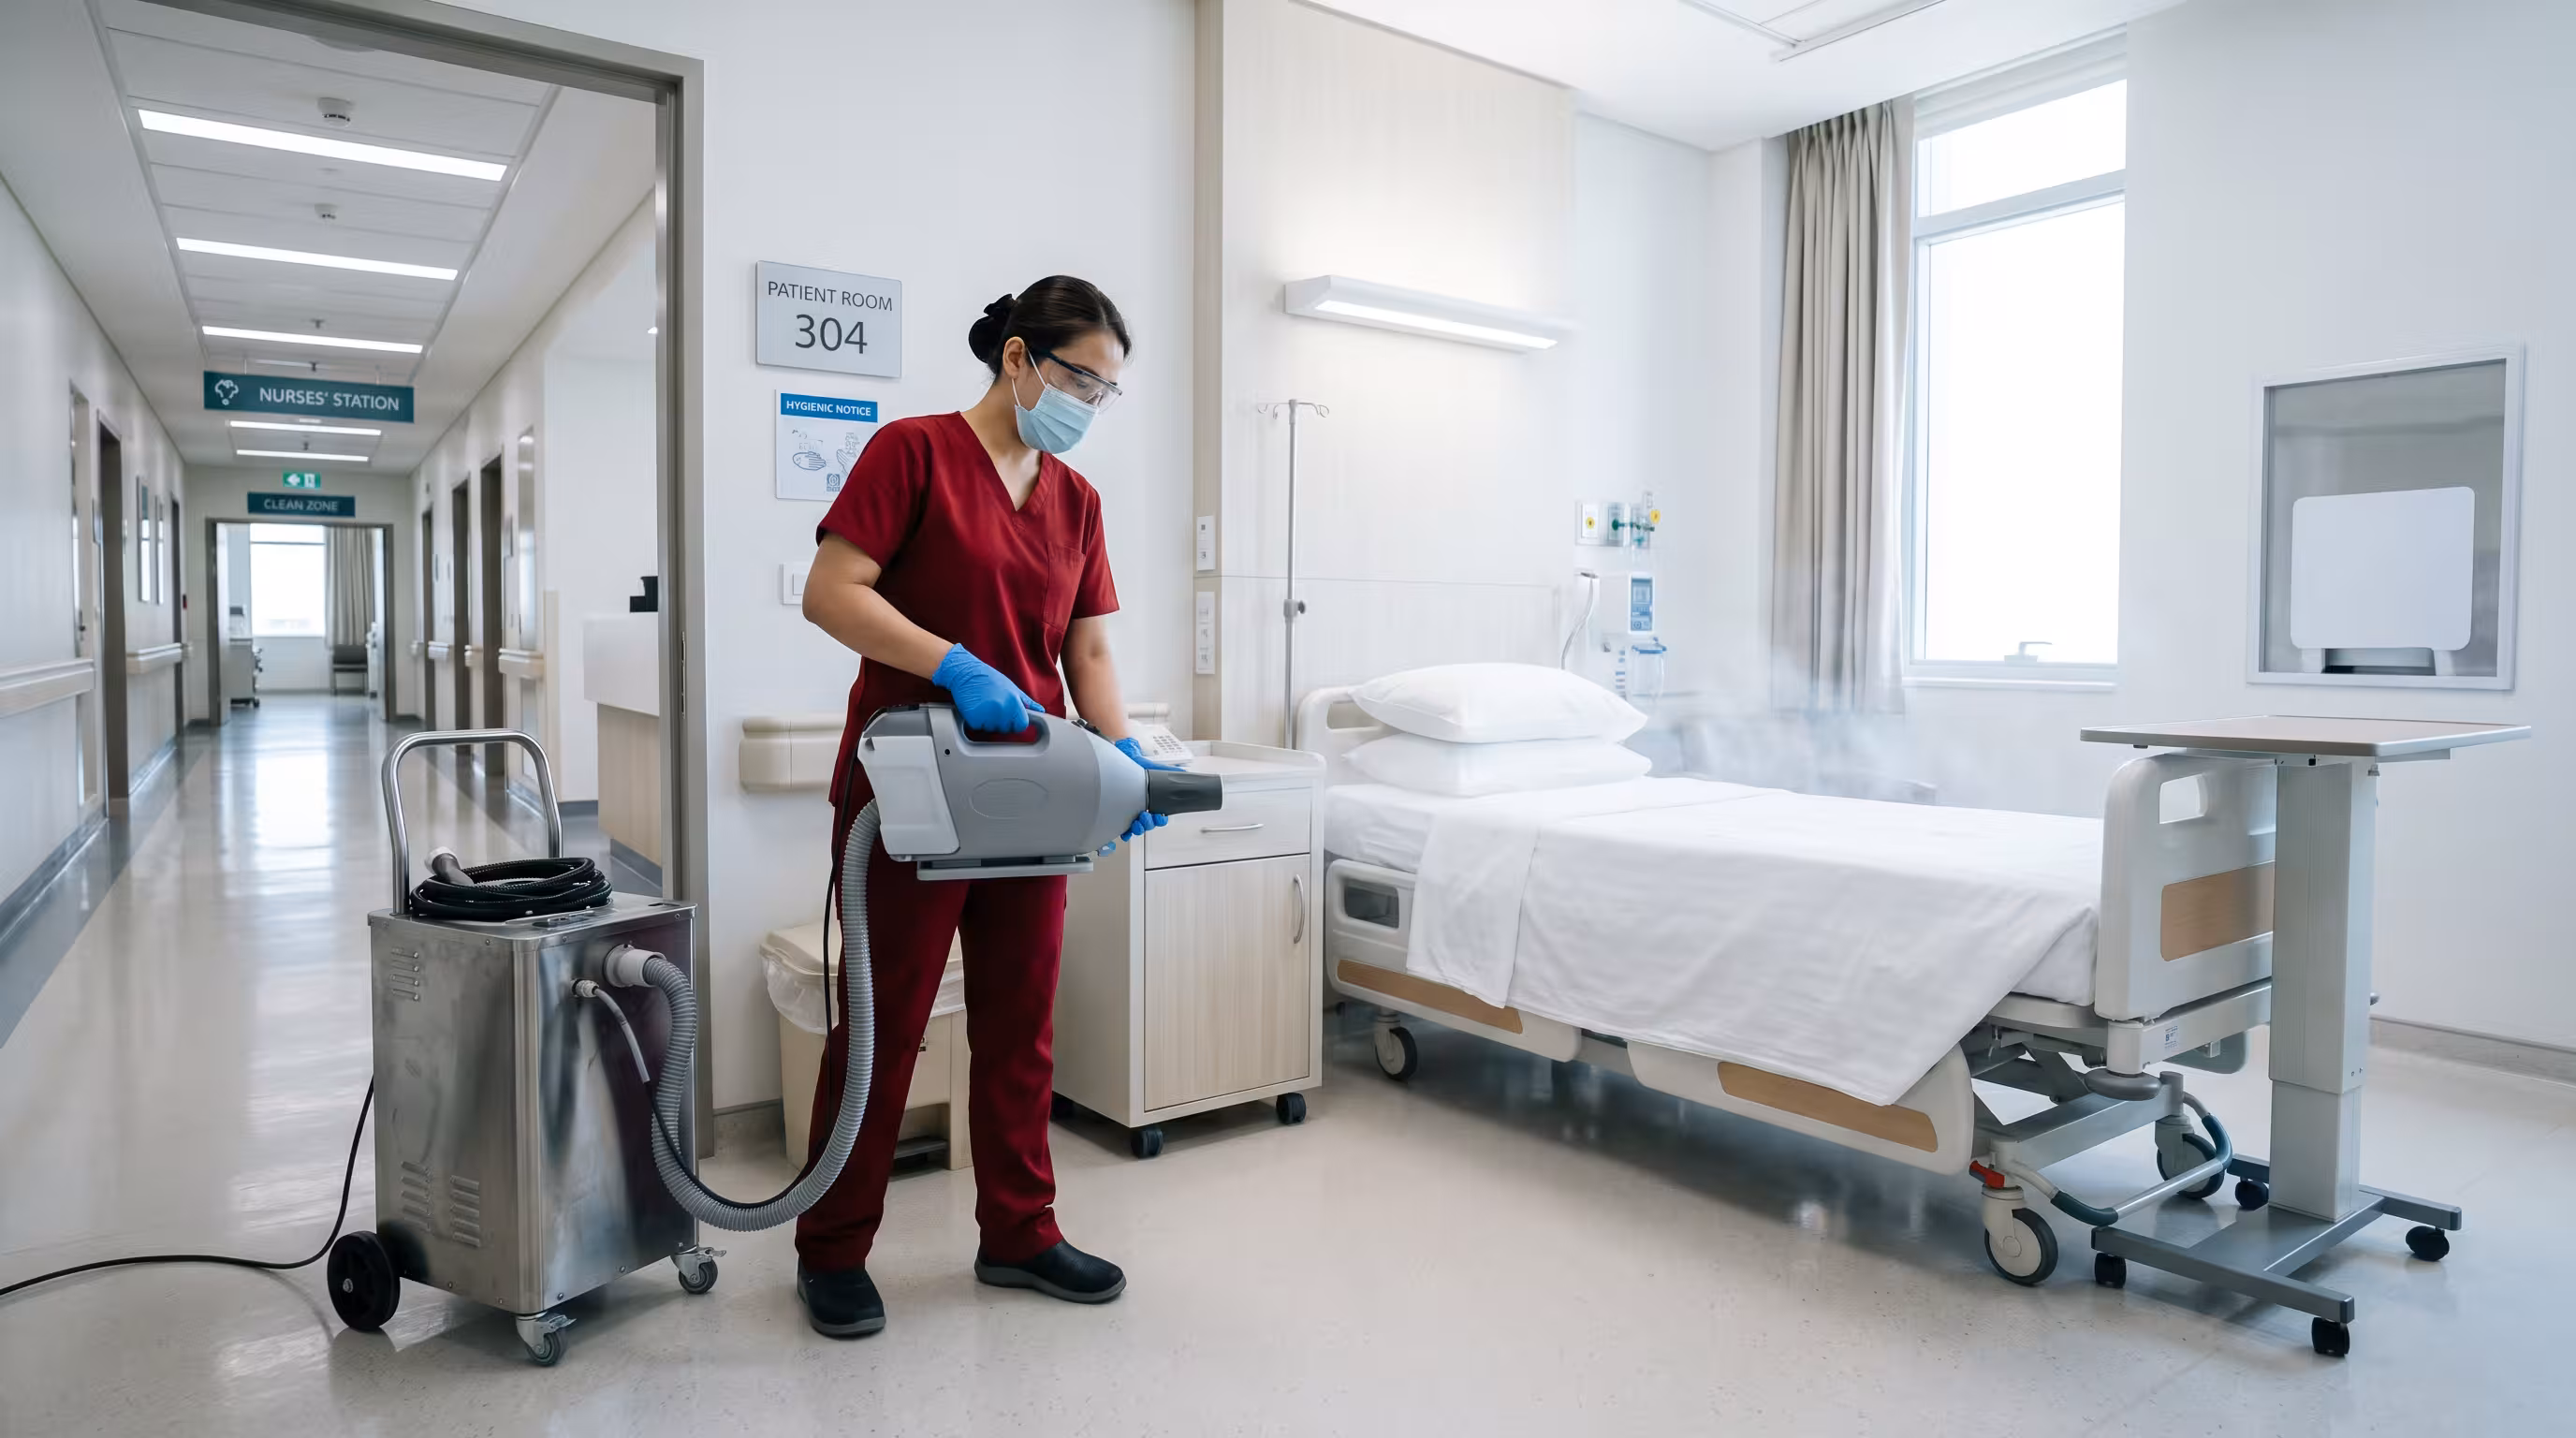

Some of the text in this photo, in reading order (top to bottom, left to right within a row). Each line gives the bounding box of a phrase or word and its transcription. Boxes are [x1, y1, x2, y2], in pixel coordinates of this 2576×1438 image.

[768, 281, 893, 312] PATIENT ROOM
[795, 314, 868, 354] 304
[259, 387, 400, 411] NURSES' STATION
[786, 400, 871, 417] HYGIENIC NOTICE
[263, 498, 338, 512] CLEAN ZONE
